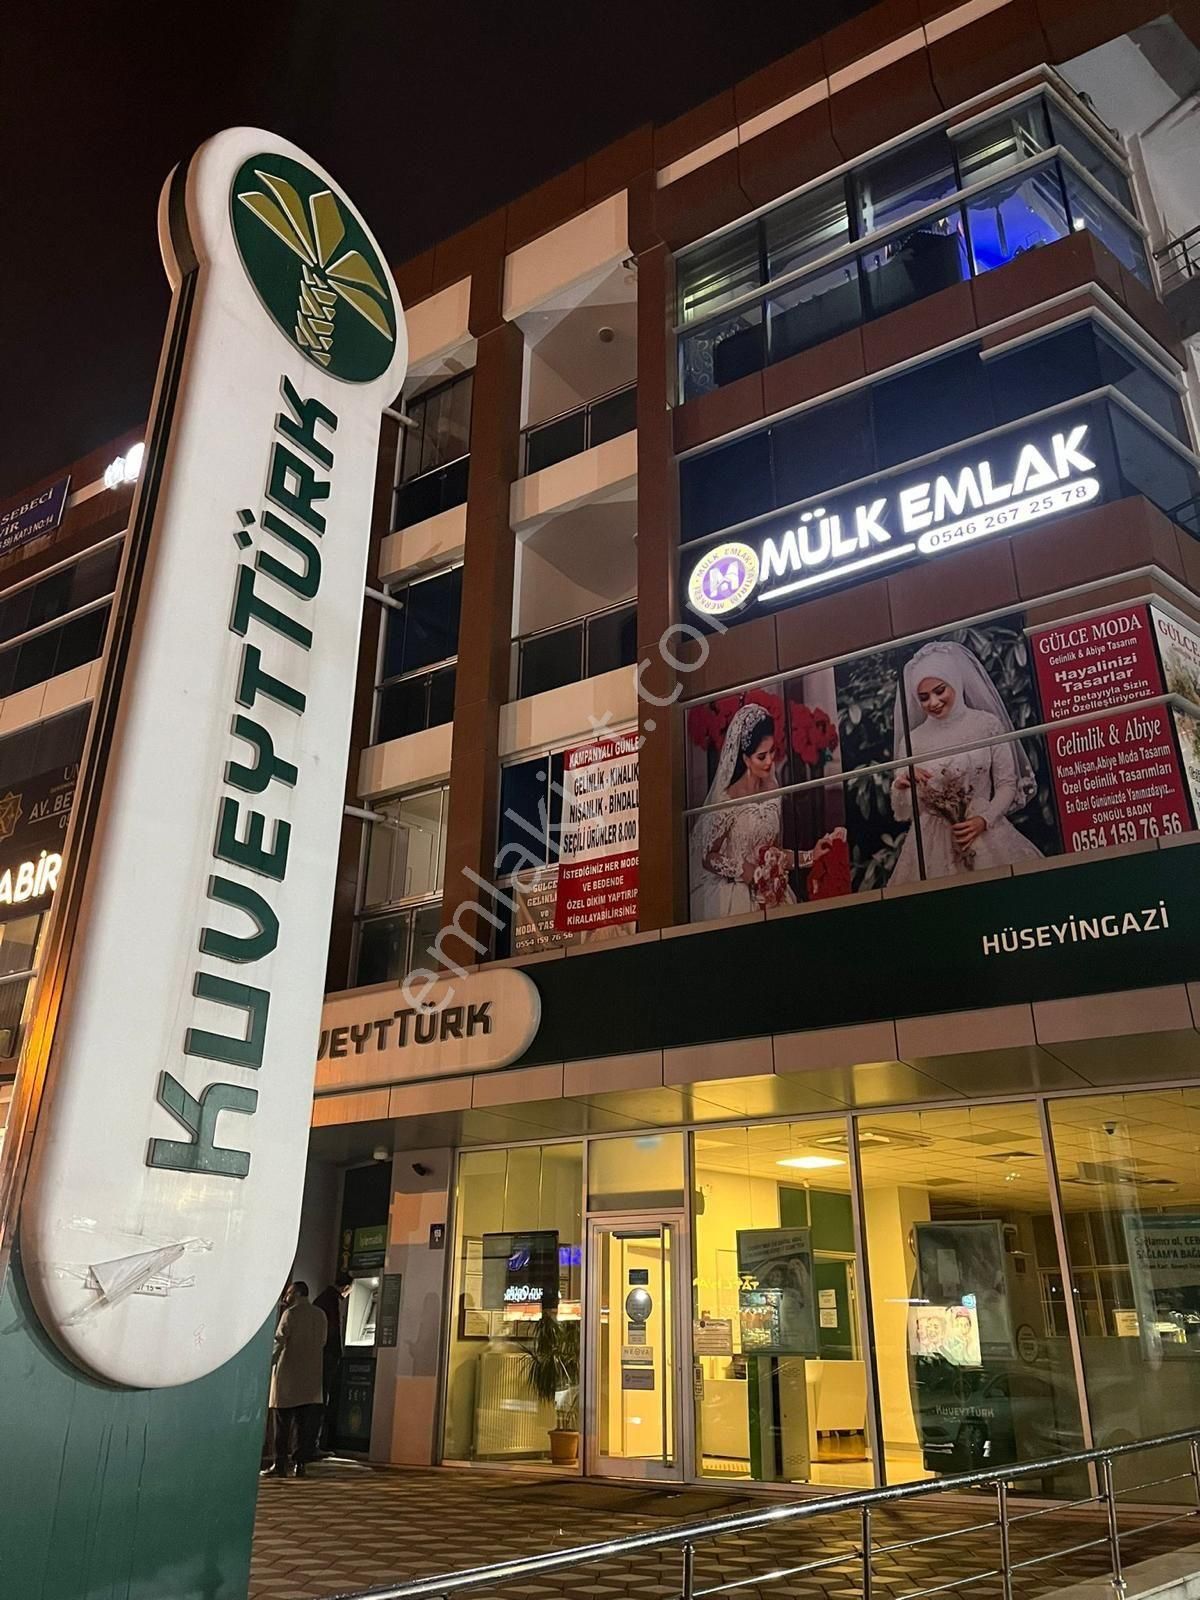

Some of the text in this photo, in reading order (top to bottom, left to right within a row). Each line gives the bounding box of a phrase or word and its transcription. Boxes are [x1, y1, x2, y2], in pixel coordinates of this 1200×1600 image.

[759, 425, 1097, 582] MÜLK EMLAK
[929, 485, 1089, 548] 0546 267 25 78
[1039, 613, 1143, 654] GÜLCE MODA
[1049, 637, 1137, 666] Gelinlik & Abiye Tasarım
[1054, 652, 1138, 682] Hayalinizi
[1062, 668, 1134, 693] Tasarlar
[1053, 679, 1149, 709] Her Detayıyla Sizin
[1056, 716, 1161, 757] Gelinlik & Abiye
[569, 743, 614, 768] KAMPANYALI
[1117, 749, 1139, 765] Moda
[1139, 744, 1171, 760] Tasarım
[574, 767, 605, 797] GELİNLİK
[1062, 778, 1082, 795] Özel
[1083, 771, 1119, 791] Gelinlik
[1118, 763, 1172, 783] Tasarımları
[29, 790, 75, 820] AV. BE
[569, 797, 603, 825] NİŞANLIK
[1065, 800, 1075, 814] En
[1075, 796, 1090, 812] Özel
[1092, 802, 1153, 824] SONGÜL BADAY
[563, 820, 636, 858] SEÇİLİ ÜRÜNLER 8.000
[1072, 812, 1183, 852] 0554 159 76 56
[563, 856, 640, 880] İSTEDİĞİNİZ HER MODE
[582, 875, 624, 892] VE BEDENDE
[566, 888, 639, 910] ÖZEL DİKİM YAPTIRIP
[567, 903, 637, 926] KİRALAYABİLİRSİNİZ
[982, 900, 1170, 955] HÜSEYİNGAZİ
[515, 923, 537, 937] MODA
[1180, 1246, 1200, 1260] BAĞ
